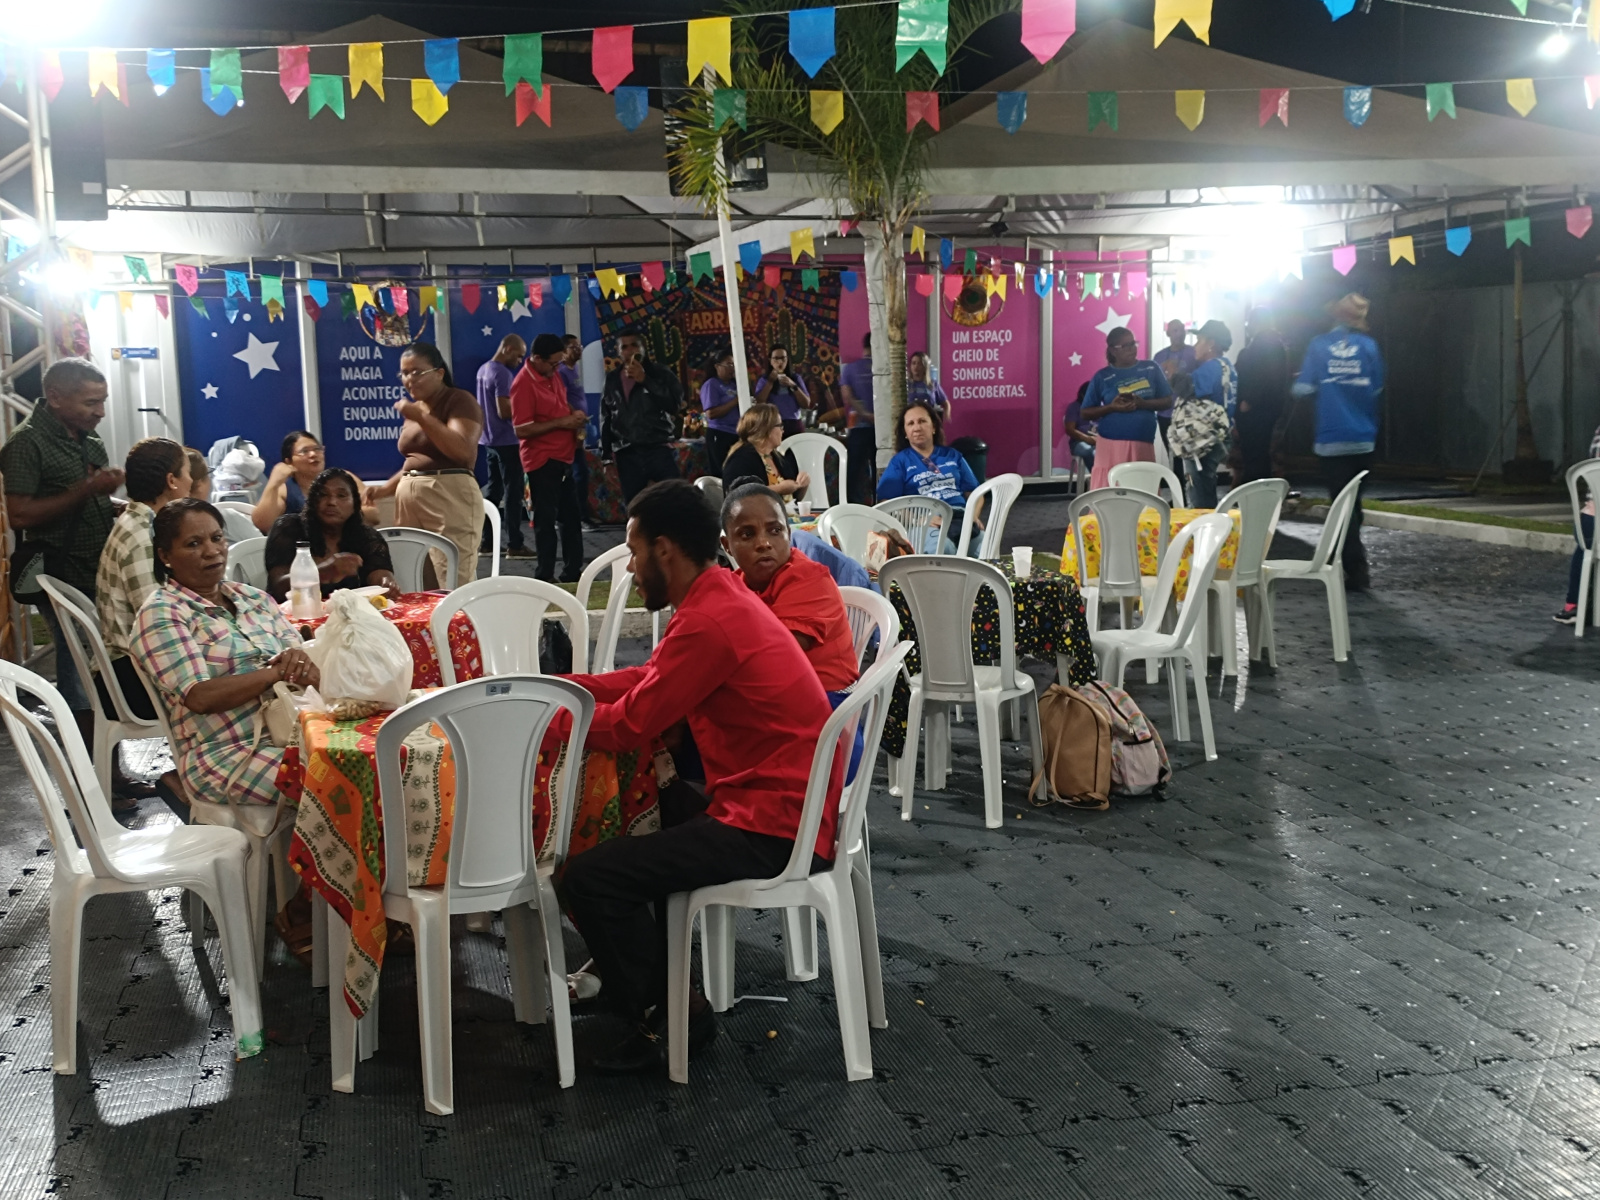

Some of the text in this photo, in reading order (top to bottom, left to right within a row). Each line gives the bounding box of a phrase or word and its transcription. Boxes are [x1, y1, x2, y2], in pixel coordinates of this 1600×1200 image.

[690, 305, 756, 330] ARRÁ
[952, 329, 1012, 347] UM ESPAÇO
[339, 346, 383, 362] AQUI A
[952, 348, 999, 363] CHEIO DE
[341, 366, 383, 381] MAGIA
[952, 366, 1004, 381] SONHOS E
[342, 385, 407, 401] ACONTECE
[952, 384, 1027, 400] DESCOBERTAS.
[344, 426, 402, 441] DORMIM
